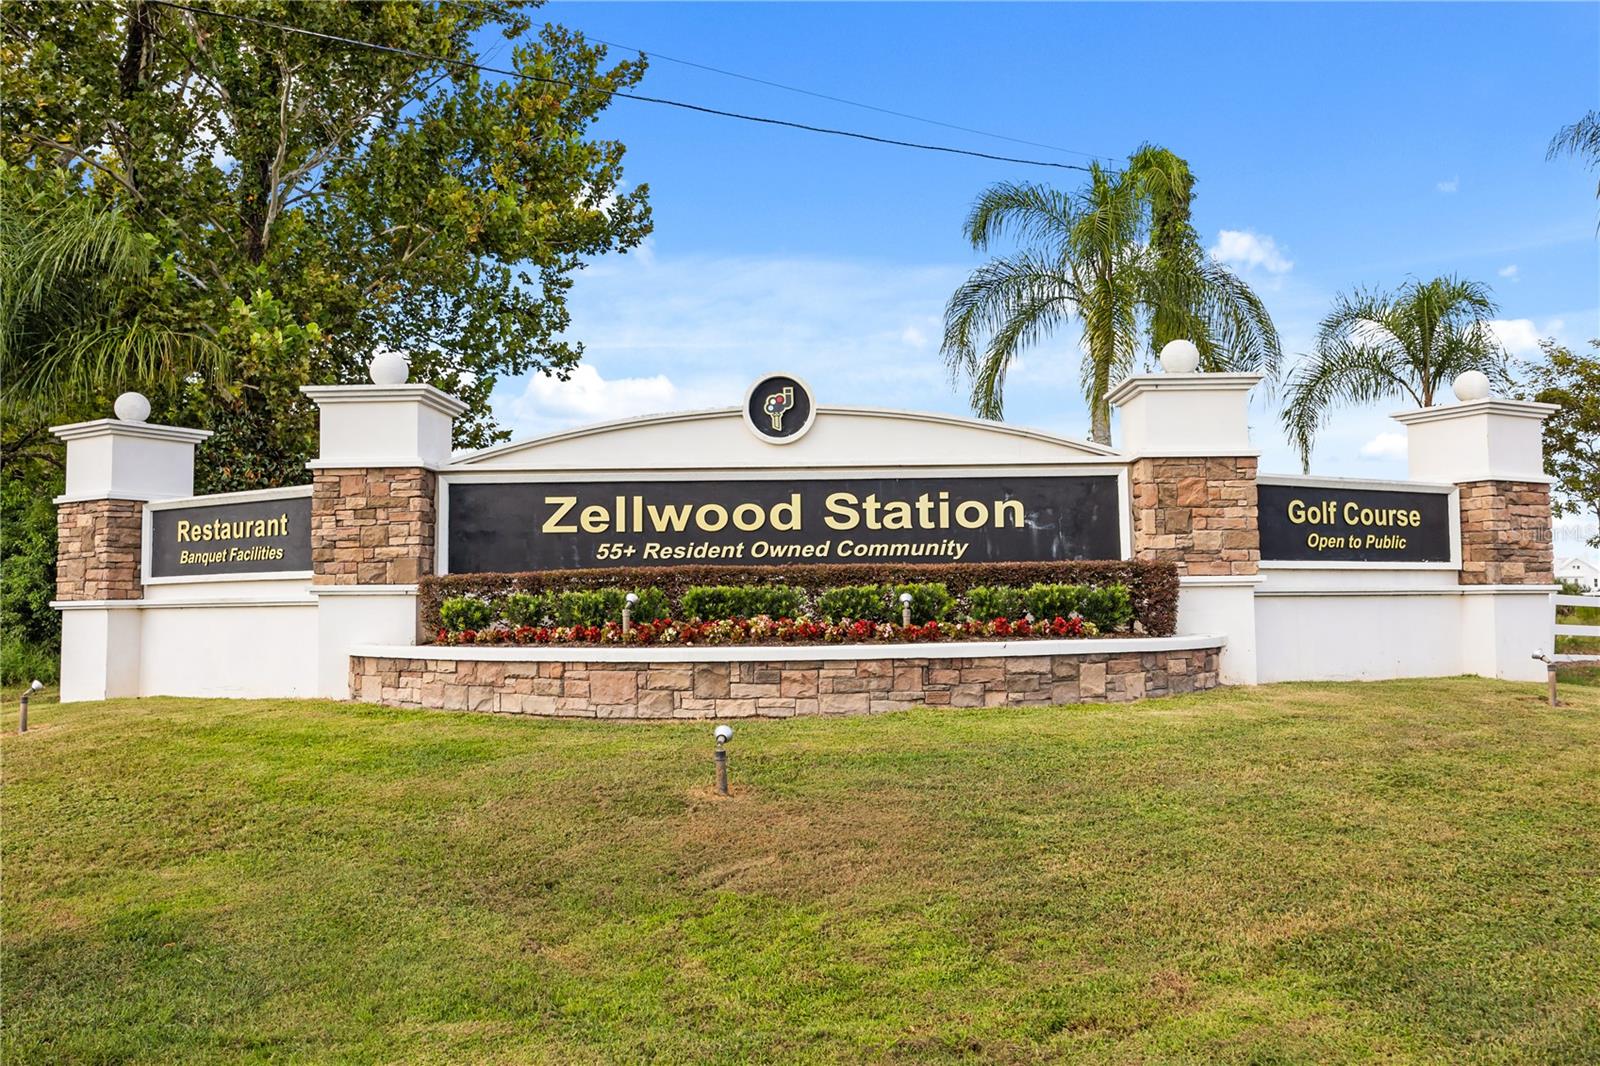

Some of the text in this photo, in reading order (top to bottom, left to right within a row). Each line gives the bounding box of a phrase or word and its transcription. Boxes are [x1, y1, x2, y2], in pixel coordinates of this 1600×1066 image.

[541, 491, 1026, 534] Zellwood Station
[1287, 499, 1421, 527] Golf Course
[176, 514, 288, 543] Restaurant
[596, 539, 968, 560] 55+ Resident Owned Community
[1307, 532, 1407, 551] Open to Public
[180, 546, 283, 567] Banquet Facilities
